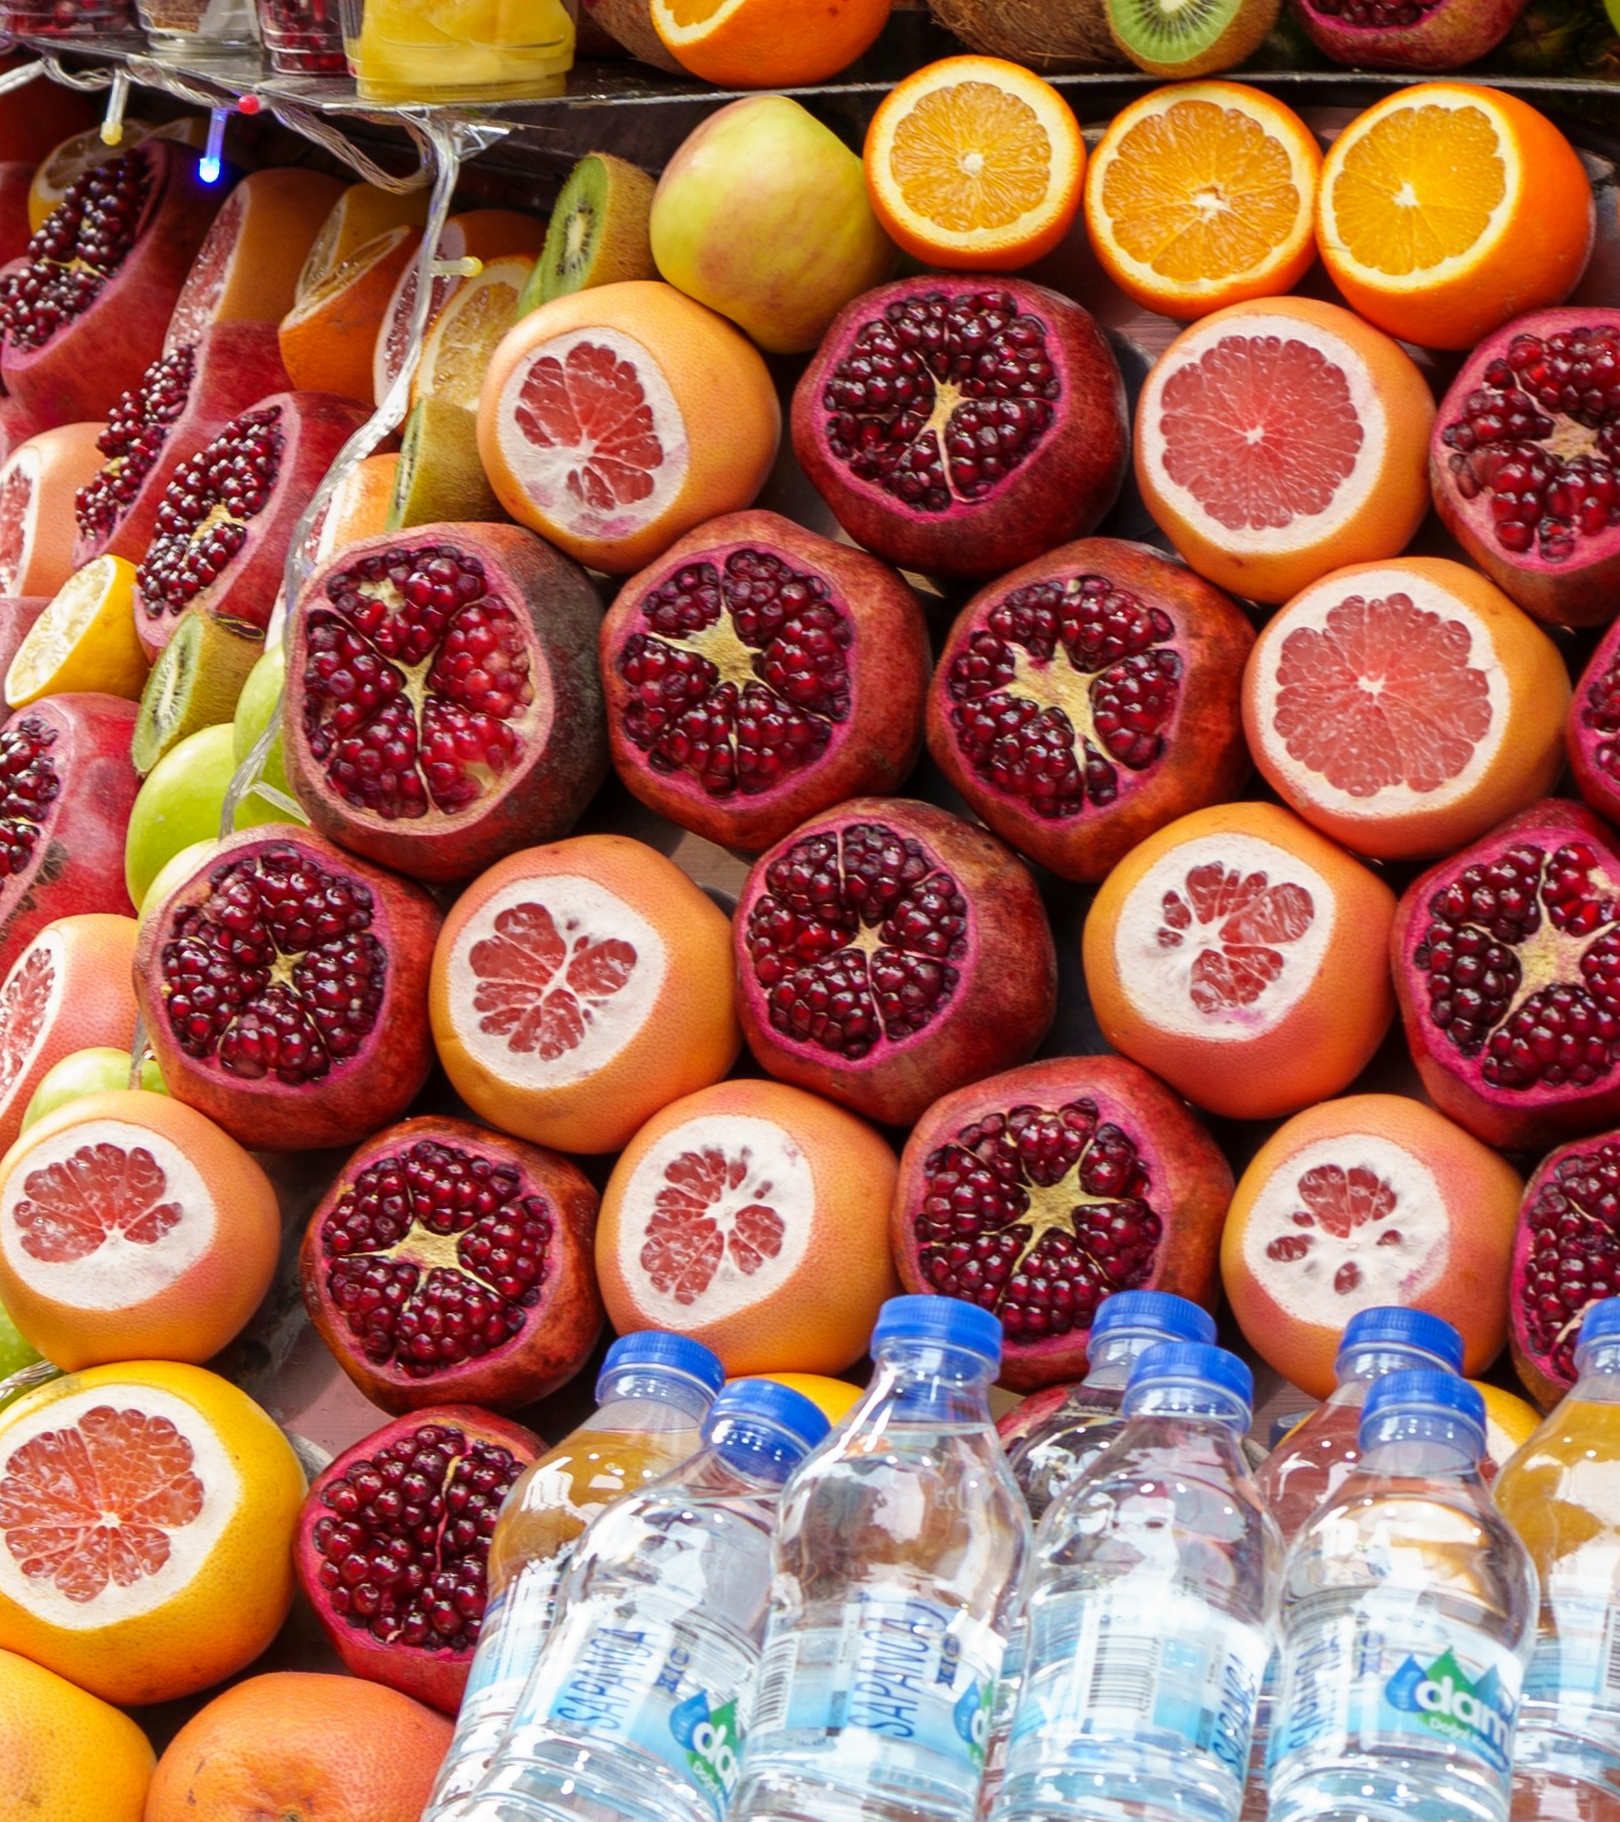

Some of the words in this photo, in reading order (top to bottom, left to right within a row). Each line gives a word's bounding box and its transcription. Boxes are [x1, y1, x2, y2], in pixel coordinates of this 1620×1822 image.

[557, 1627, 661, 1730] SAPANCA
[847, 1616, 934, 1738] SAPANCA
[1415, 1675, 1517, 1752] dam
